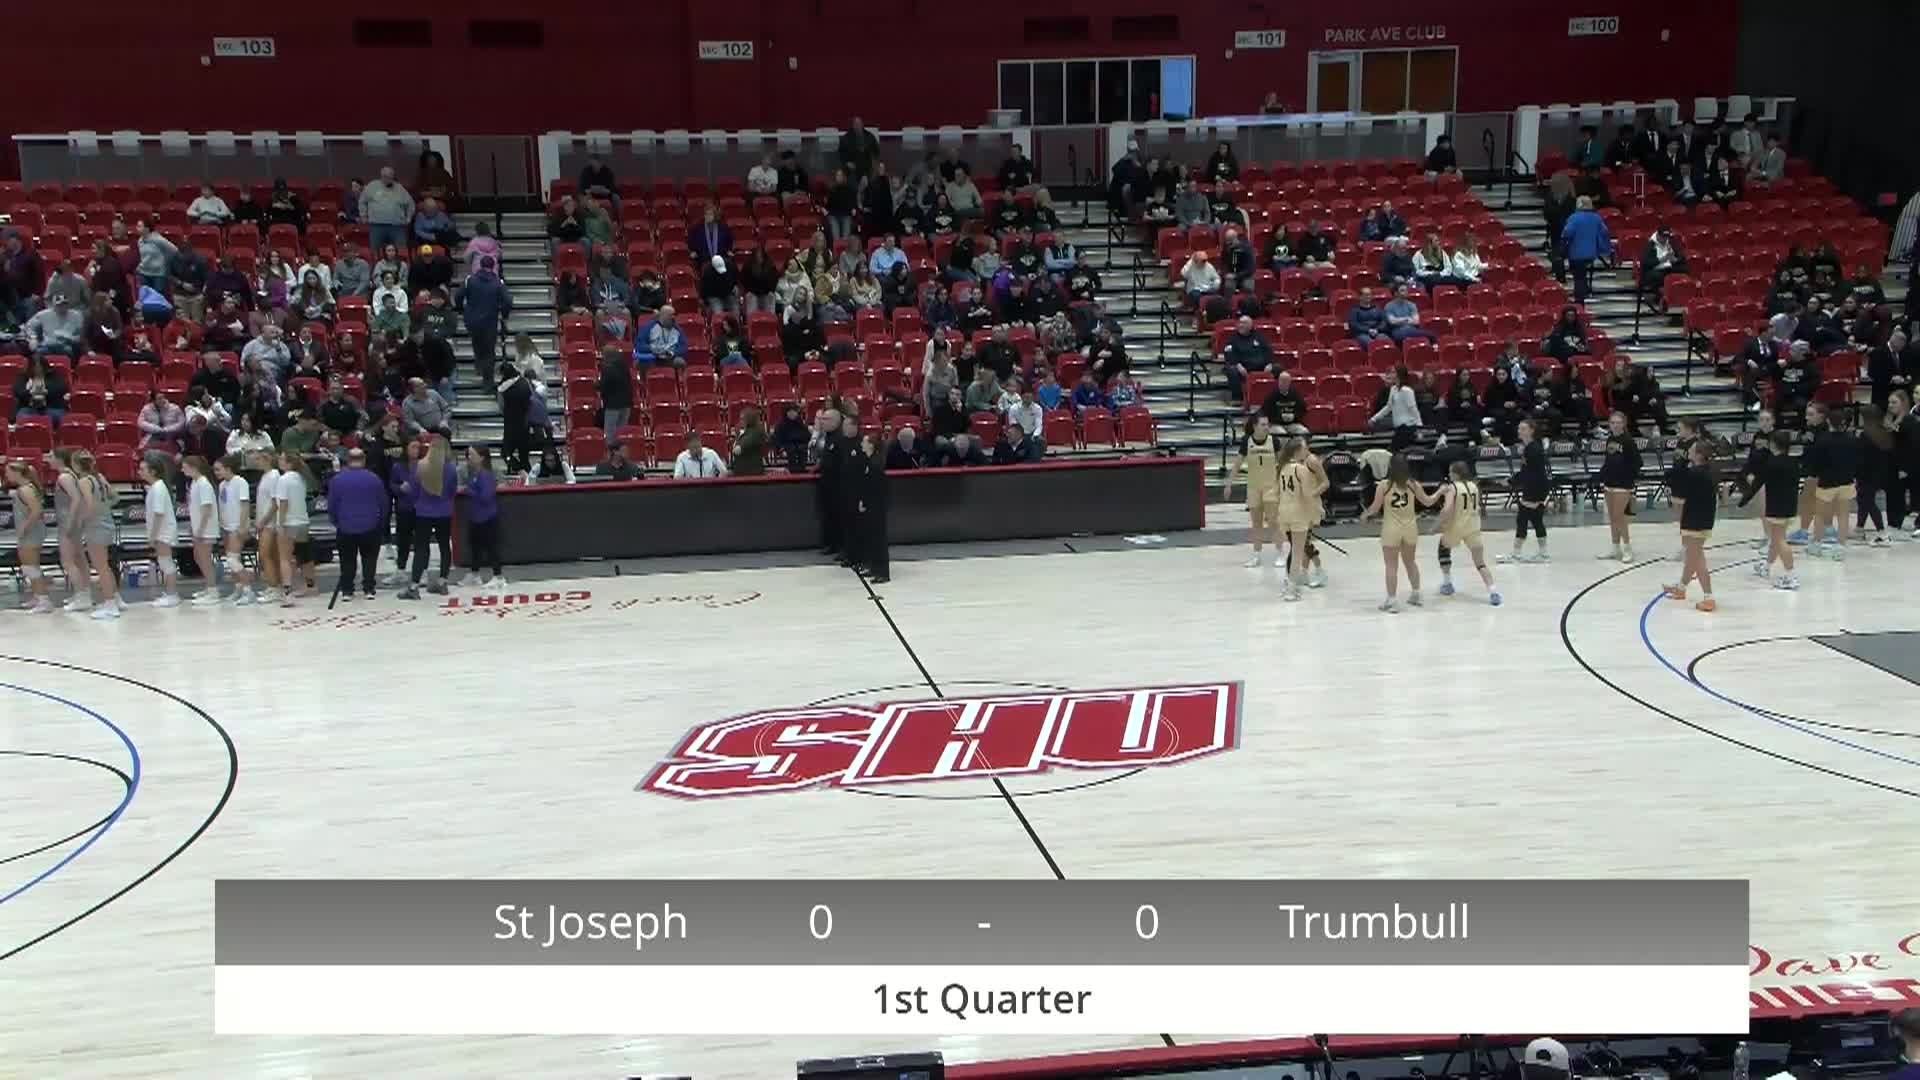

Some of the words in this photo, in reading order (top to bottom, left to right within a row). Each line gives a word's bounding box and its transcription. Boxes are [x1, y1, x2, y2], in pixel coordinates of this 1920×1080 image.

[1590, 19, 1617, 32] 100
[1256, 33, 1282, 45] 101
[1325, 29, 1367, 42] PARK
[1370, 27, 1401, 41] AVE
[1405, 25, 1447, 40] CLUB
[240, 41, 272, 54] 103
[722, 43, 752, 56] 102
[1281, 475, 1295, 492] 14
[1391, 493, 1409, 508] 23
[439, 591, 591, 608] COURT
[634, 680, 1245, 800] SHU
